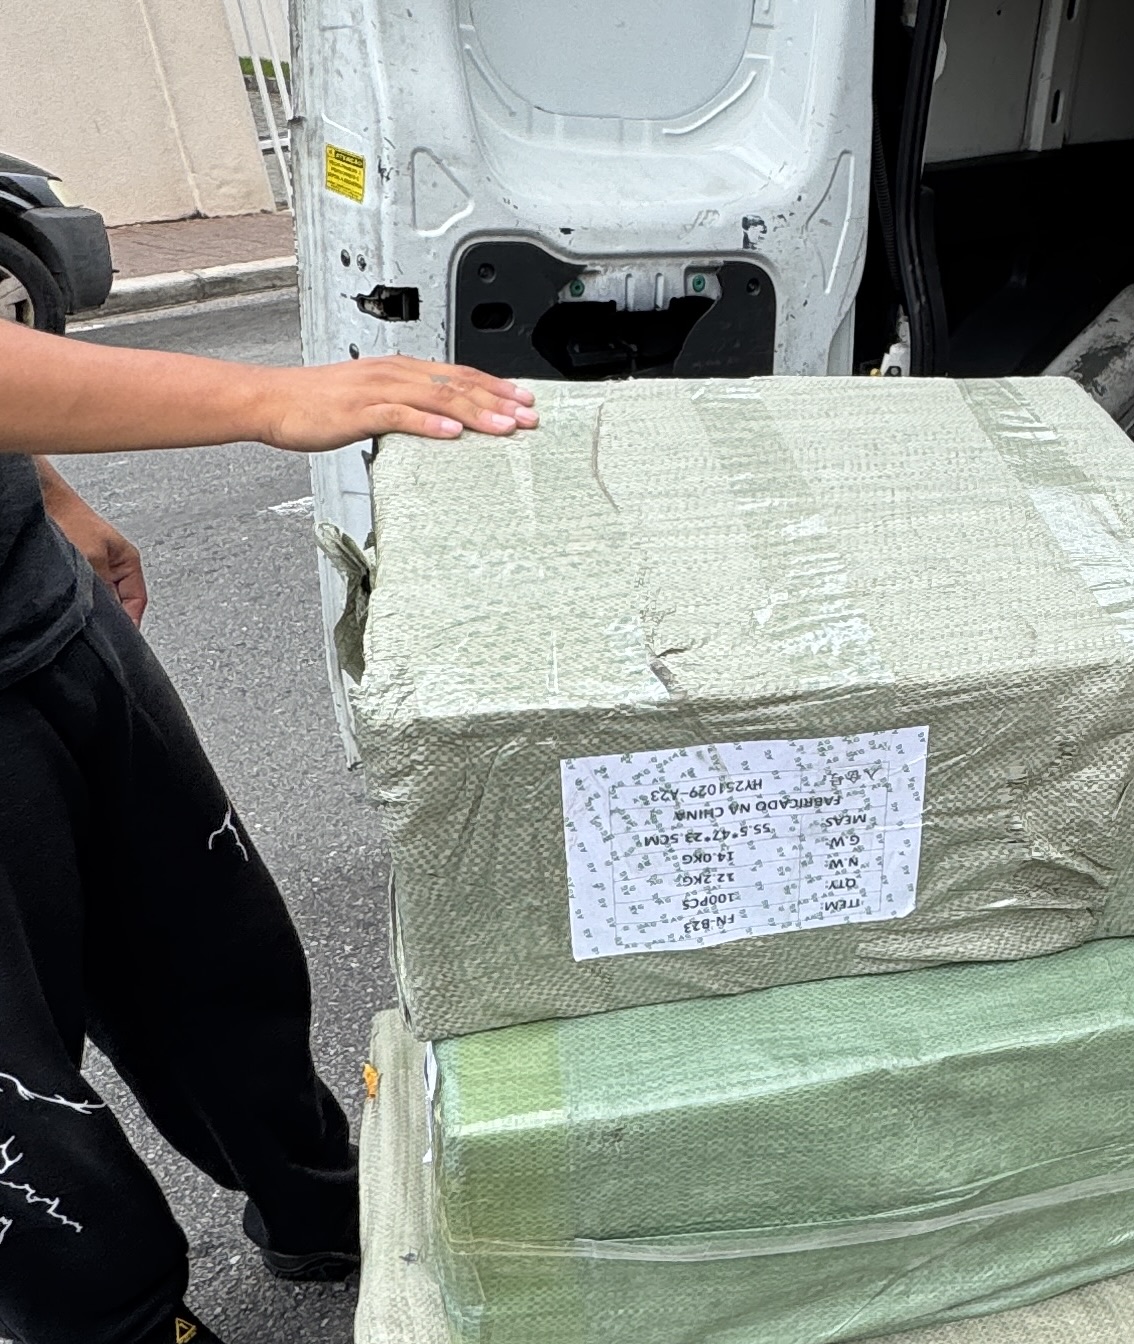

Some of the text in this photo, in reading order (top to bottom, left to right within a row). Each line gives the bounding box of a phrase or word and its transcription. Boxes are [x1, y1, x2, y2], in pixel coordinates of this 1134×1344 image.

[650, 778, 763, 802] HY251029-A23
[674, 795, 841, 822] FABRICADO NA CHINA
[681, 851, 735, 865] 14.0KG
[682, 872, 735, 887] 12.2KG
[824, 877, 856, 891] QTY:
[681, 892, 735, 910] 100PCS
[820, 898, 860, 912] ITEM:
[683, 913, 735, 934] FN-B23
